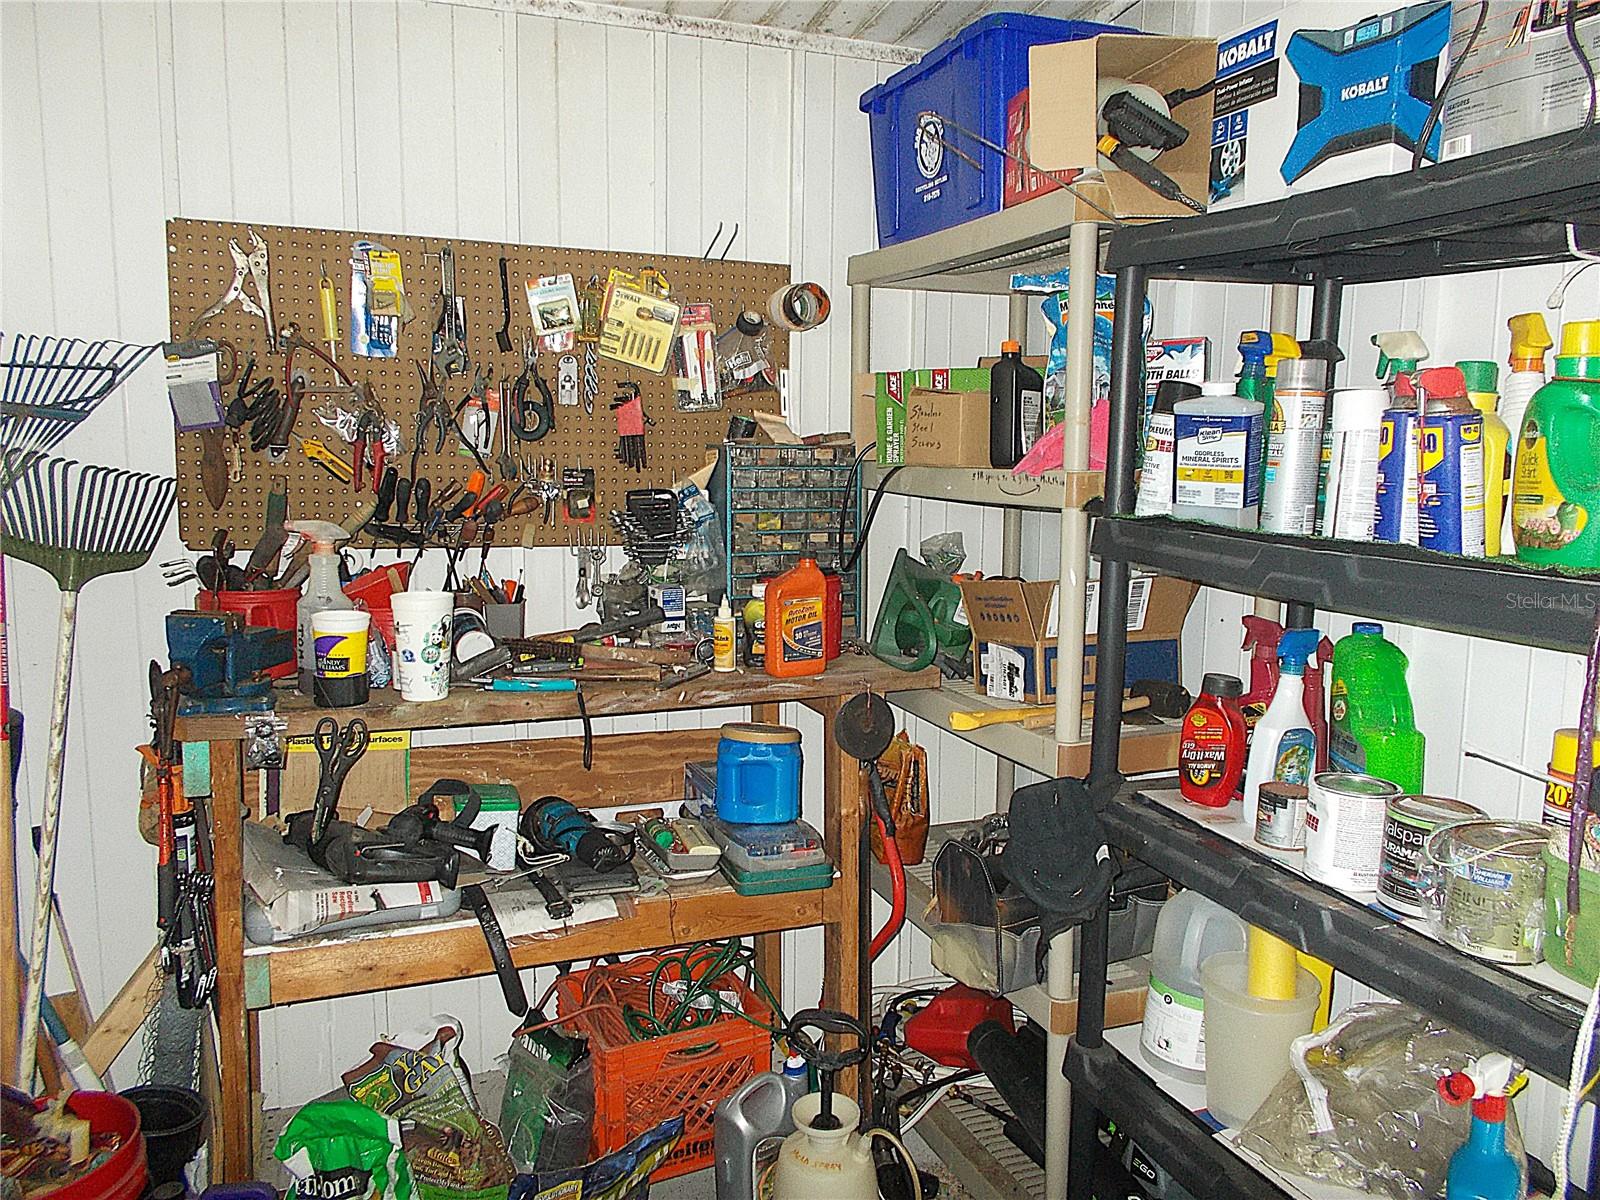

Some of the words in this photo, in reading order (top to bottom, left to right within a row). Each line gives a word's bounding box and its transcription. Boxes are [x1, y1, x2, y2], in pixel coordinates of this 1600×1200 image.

[1218, 30, 1274, 71] KOBALT
[1341, 75, 1389, 102] KOBALT
[1165, 369, 1200, 380] BALL
[889, 374, 897, 395] ACE
[886, 407, 894, 435] GARDEN
[1199, 428, 1221, 437] Klean
[886, 440, 894, 464] HOME
[1181, 455, 1211, 464] MINERAL
[785, 614, 807, 625] MOTOR
[807, 611, 818, 619] OIL
[369, 735, 403, 744] urfaces
[1182, 749, 1197, 761] Dry
[1204, 751, 1225, 761] Wax
[1132, 1157, 1156, 1180] EGO
